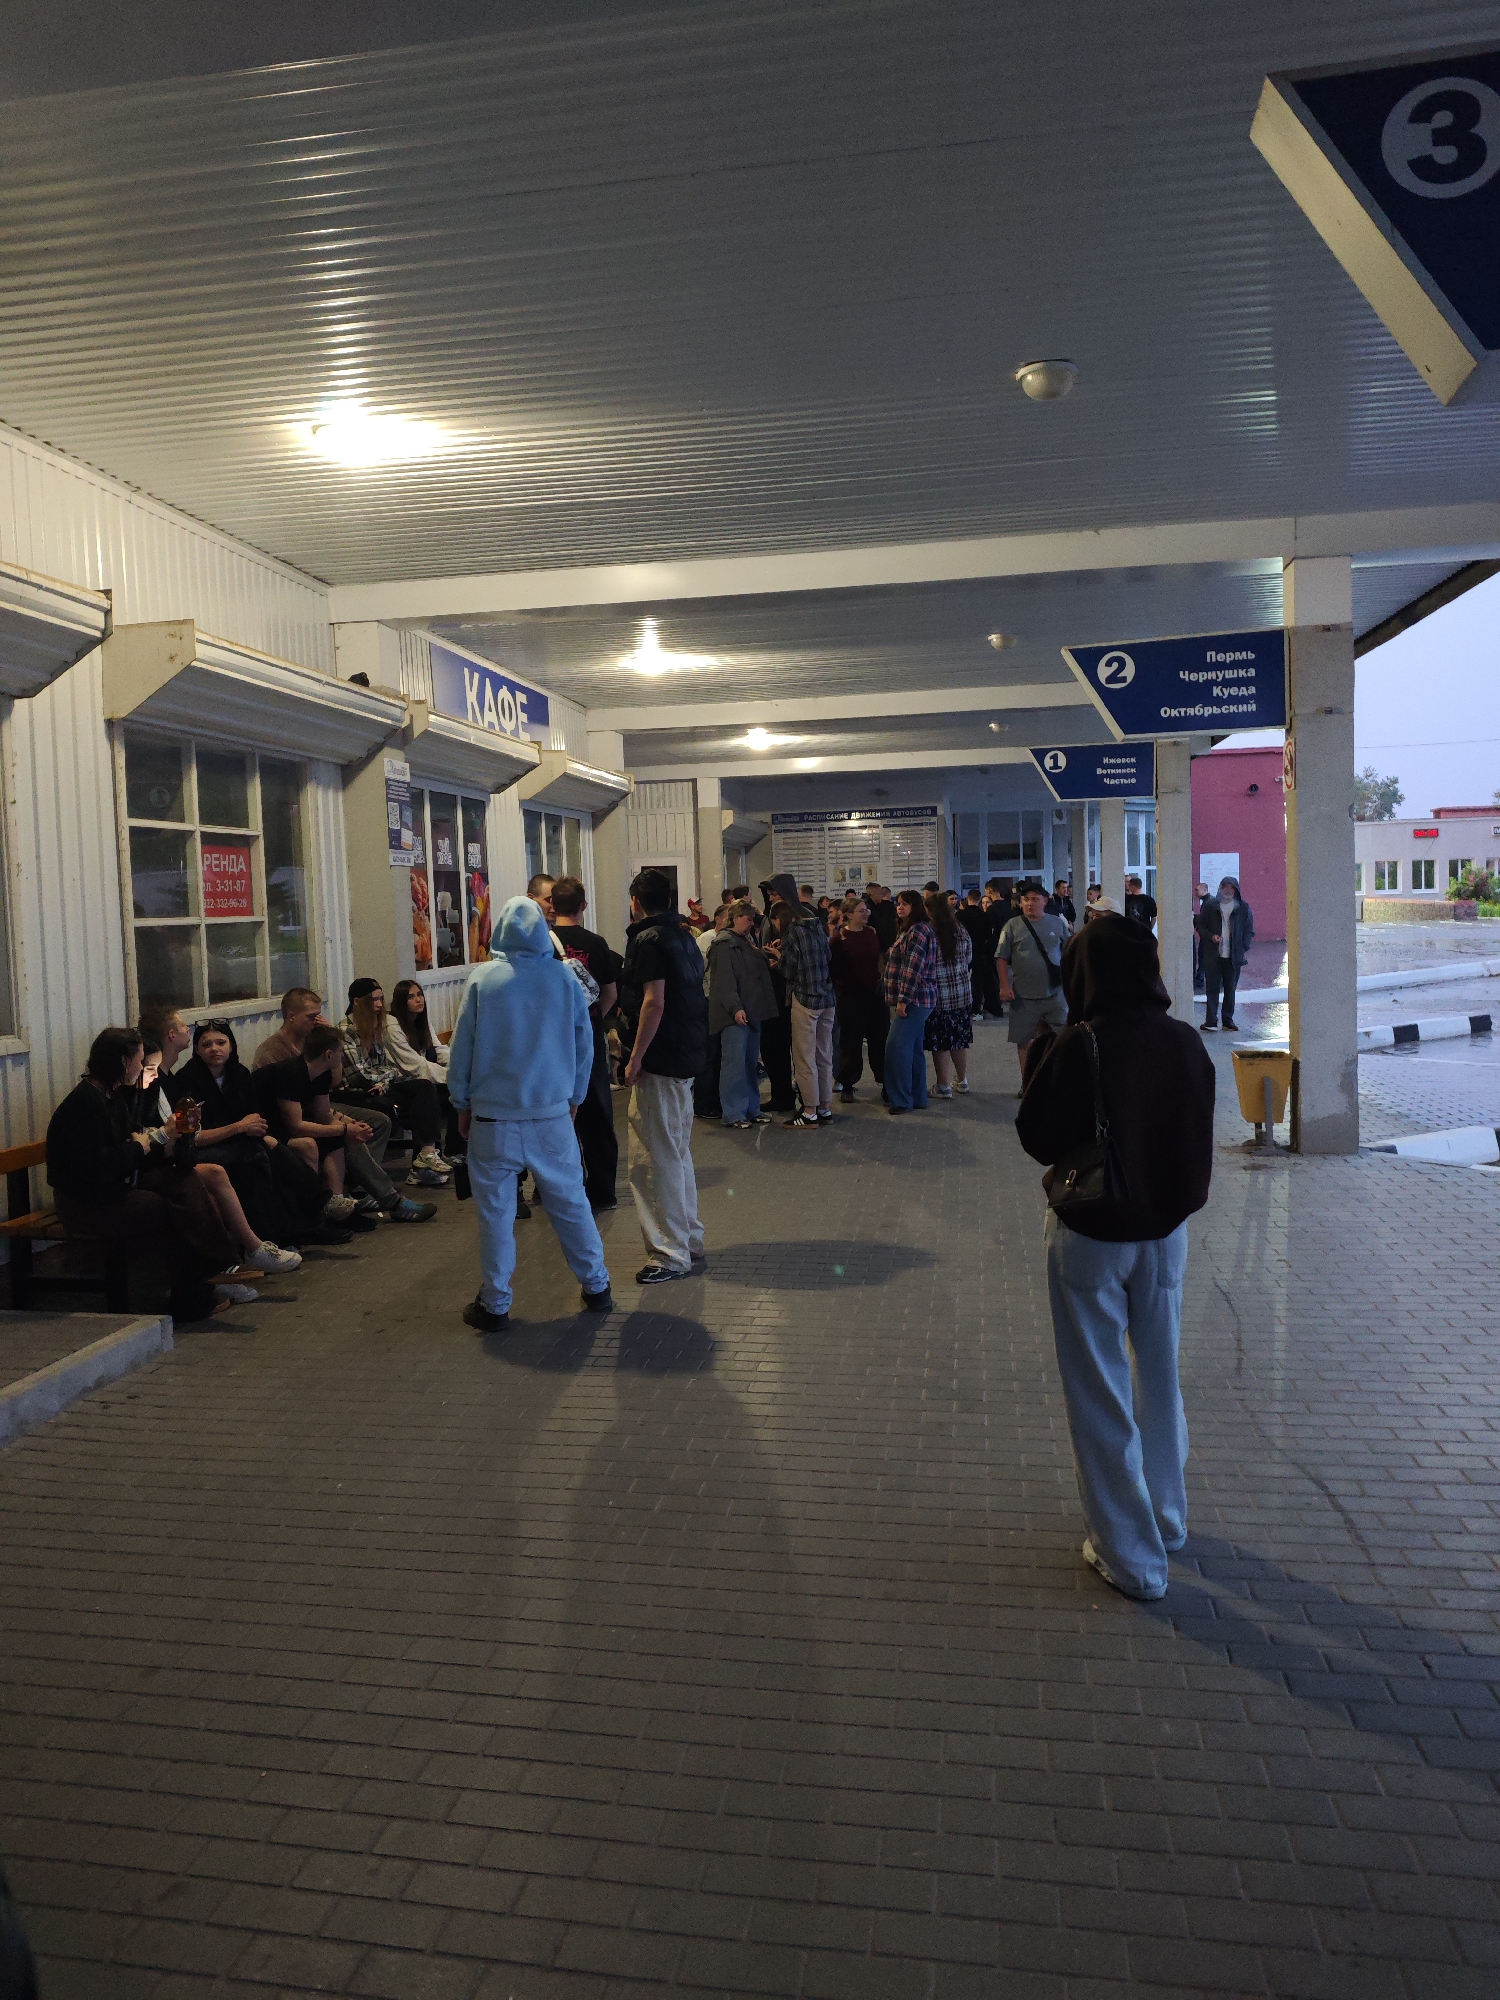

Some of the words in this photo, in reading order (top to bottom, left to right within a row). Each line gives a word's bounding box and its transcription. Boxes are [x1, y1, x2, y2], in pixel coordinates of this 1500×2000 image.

[1406, 89, 1488, 185] 3
[1206, 651, 1256, 663] Пермь
[1104, 655, 1128, 685] 2
[1179, 667, 1256, 683] Чернушка
[1212, 685, 1256, 699] Куеда
[463, 667, 532, 742] КАФЕ
[1160, 700, 1257, 717] Октябрьский
[1048, 753, 1063, 771] 1
[1103, 756, 1137, 764] Ижевск
[1096, 767, 1137, 775] Воткинск
[1103, 777, 1137, 785] Частые
[804, 812, 849, 821] РАСПИСАНИЕ
[850, 811, 891, 820] ДВИЖЕНИЯ
[892, 809, 932, 817] АВТОБУСОВ
[202, 853, 247, 875] РЕНДА
[215, 879, 246, 892] 3-31-87
